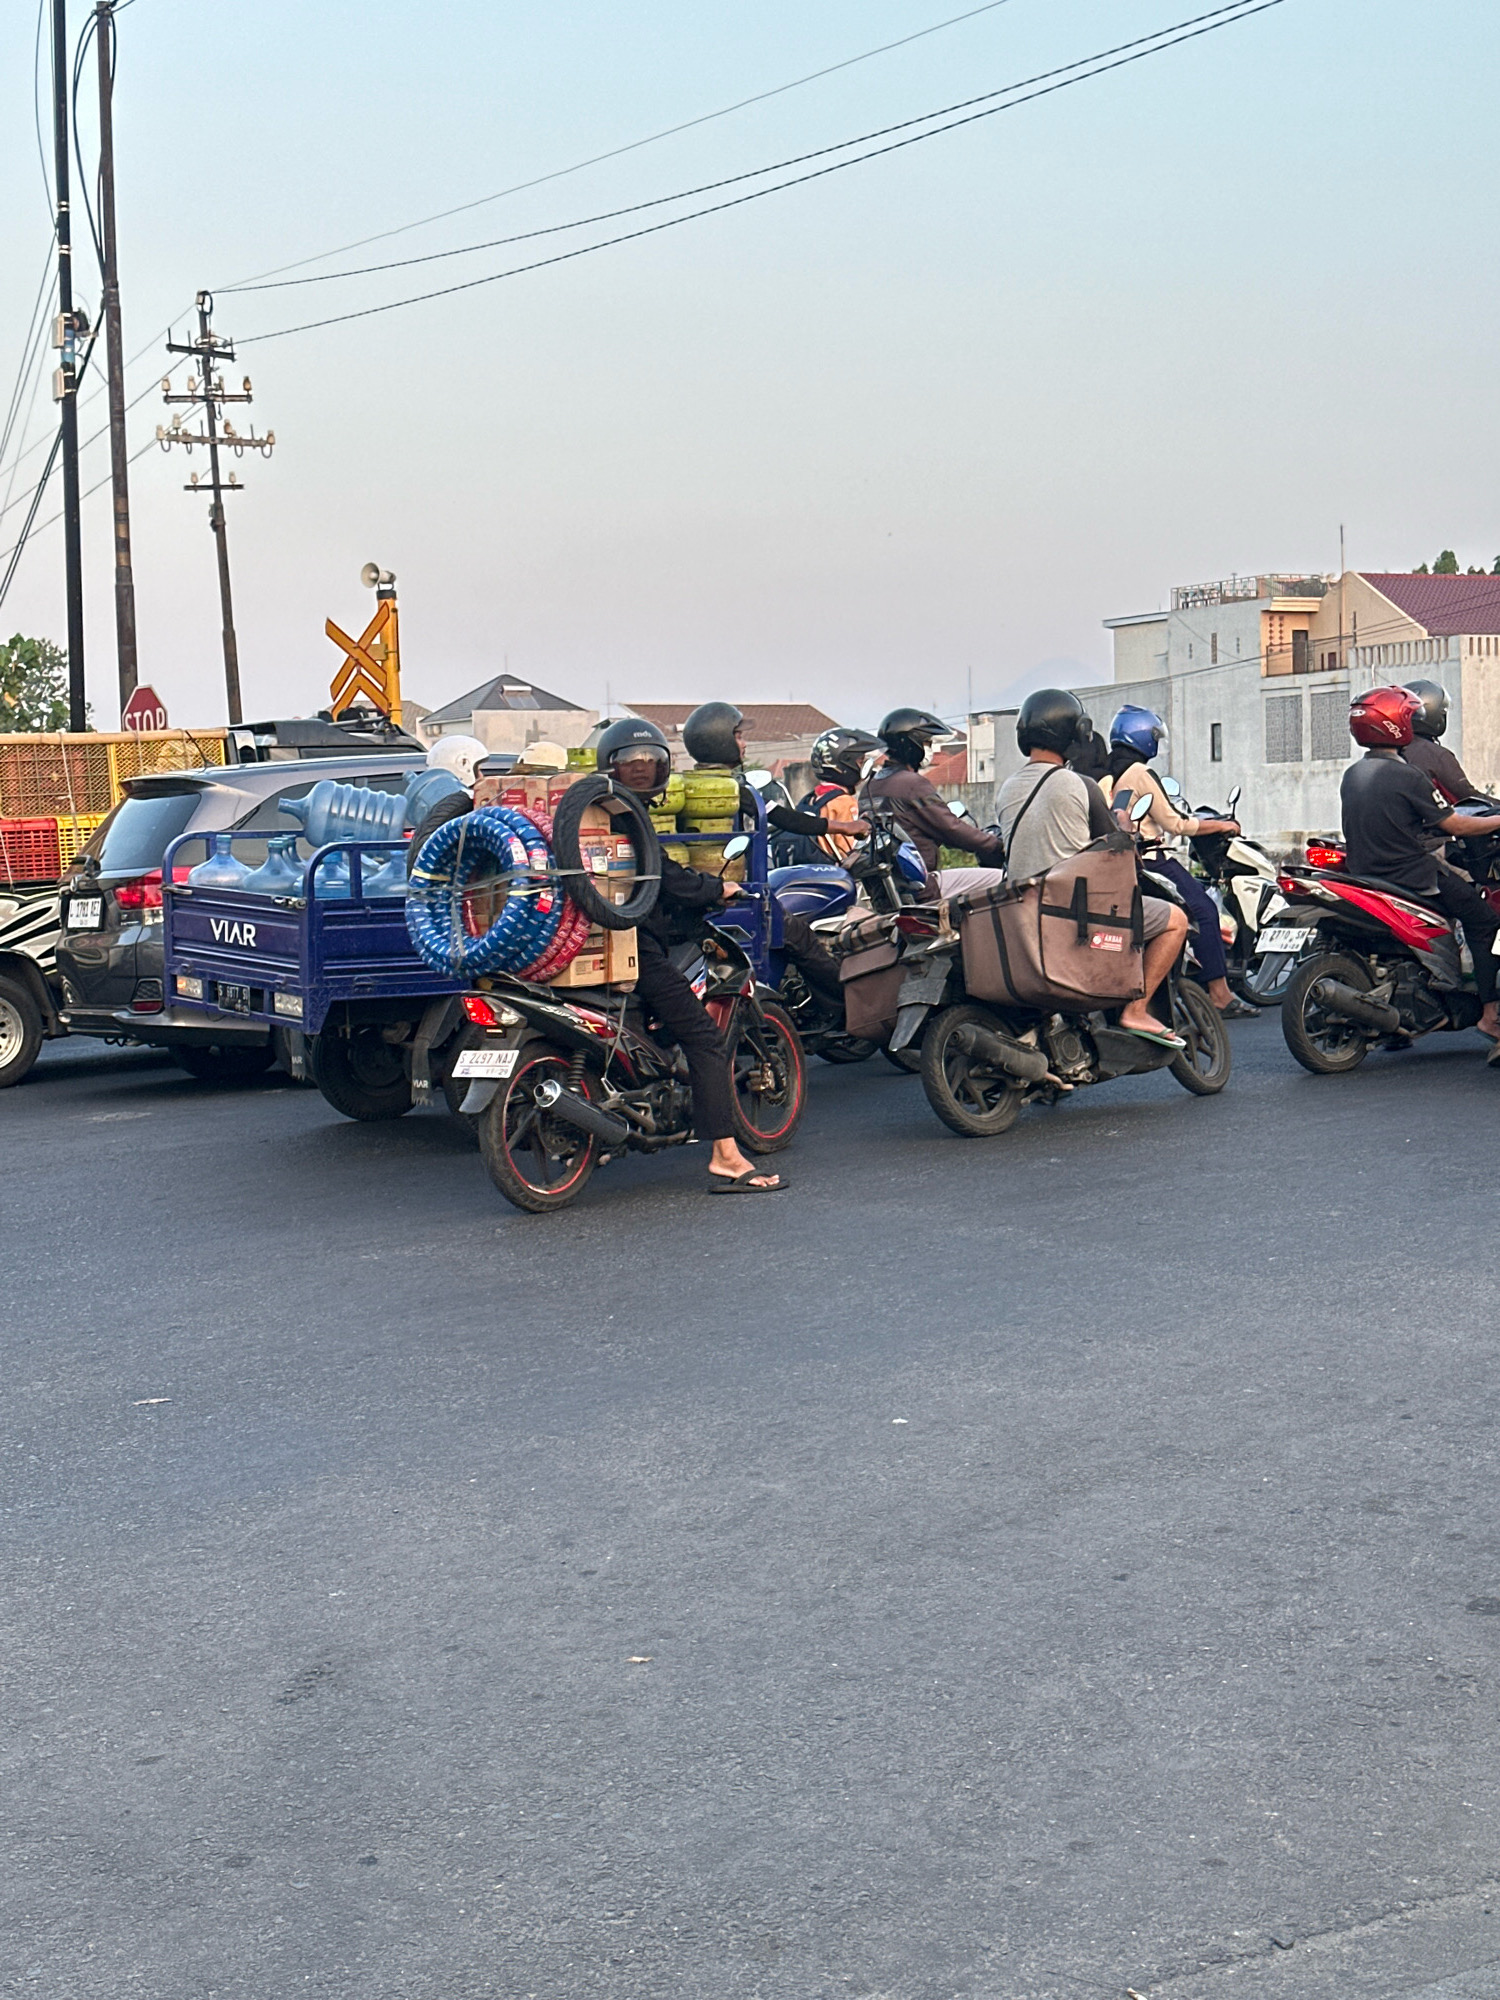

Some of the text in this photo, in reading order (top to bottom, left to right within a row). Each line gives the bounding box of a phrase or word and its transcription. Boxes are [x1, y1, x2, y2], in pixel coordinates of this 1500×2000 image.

[125, 707, 165, 730] STOP
[210, 918, 257, 947] VIAR
[460, 1052, 515, 1064] S 2497 NAJ
